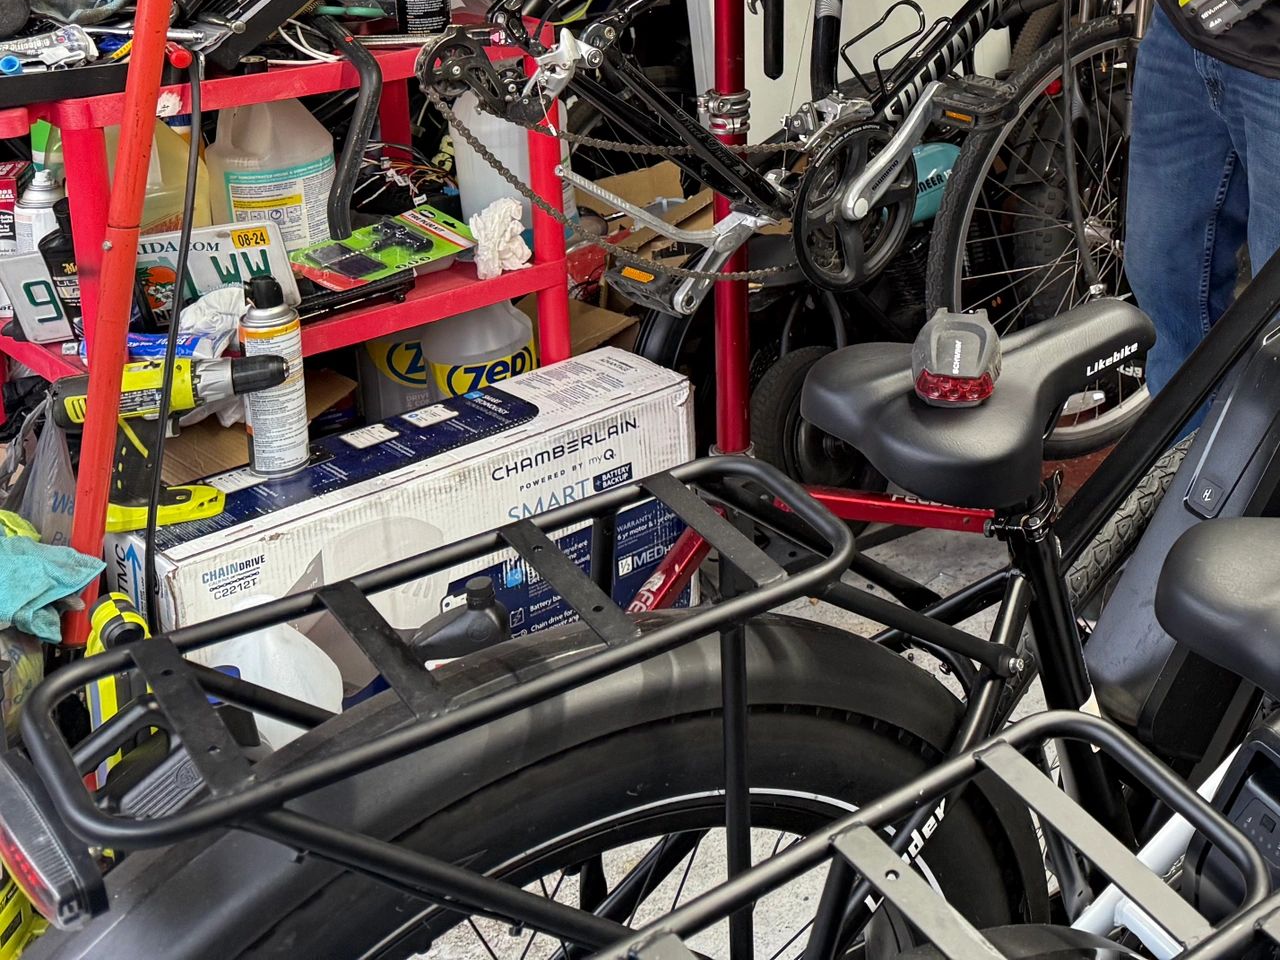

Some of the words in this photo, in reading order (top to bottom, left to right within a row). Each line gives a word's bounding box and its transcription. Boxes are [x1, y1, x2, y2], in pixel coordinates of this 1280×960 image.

[238, 232, 266, 247] 08-24
[491, 417, 640, 481] CHAMBERLAIN
[520, 469, 566, 491] POWERED
[572, 462, 583, 472] BY
[588, 448, 616, 466] myQ
[602, 465, 631, 481] BATTERY
[602, 473, 629, 489] BACKUP
[508, 479, 590, 521] SMART
[616, 513, 652, 532] WARRANTY
[622, 533, 629, 541] yr
[629, 524, 648, 537] motor
[214, 578, 257, 600] C2212T
[530, 598, 551, 613] Battery
[530, 618, 549, 632] Chain
[548, 613, 563, 626] drive
